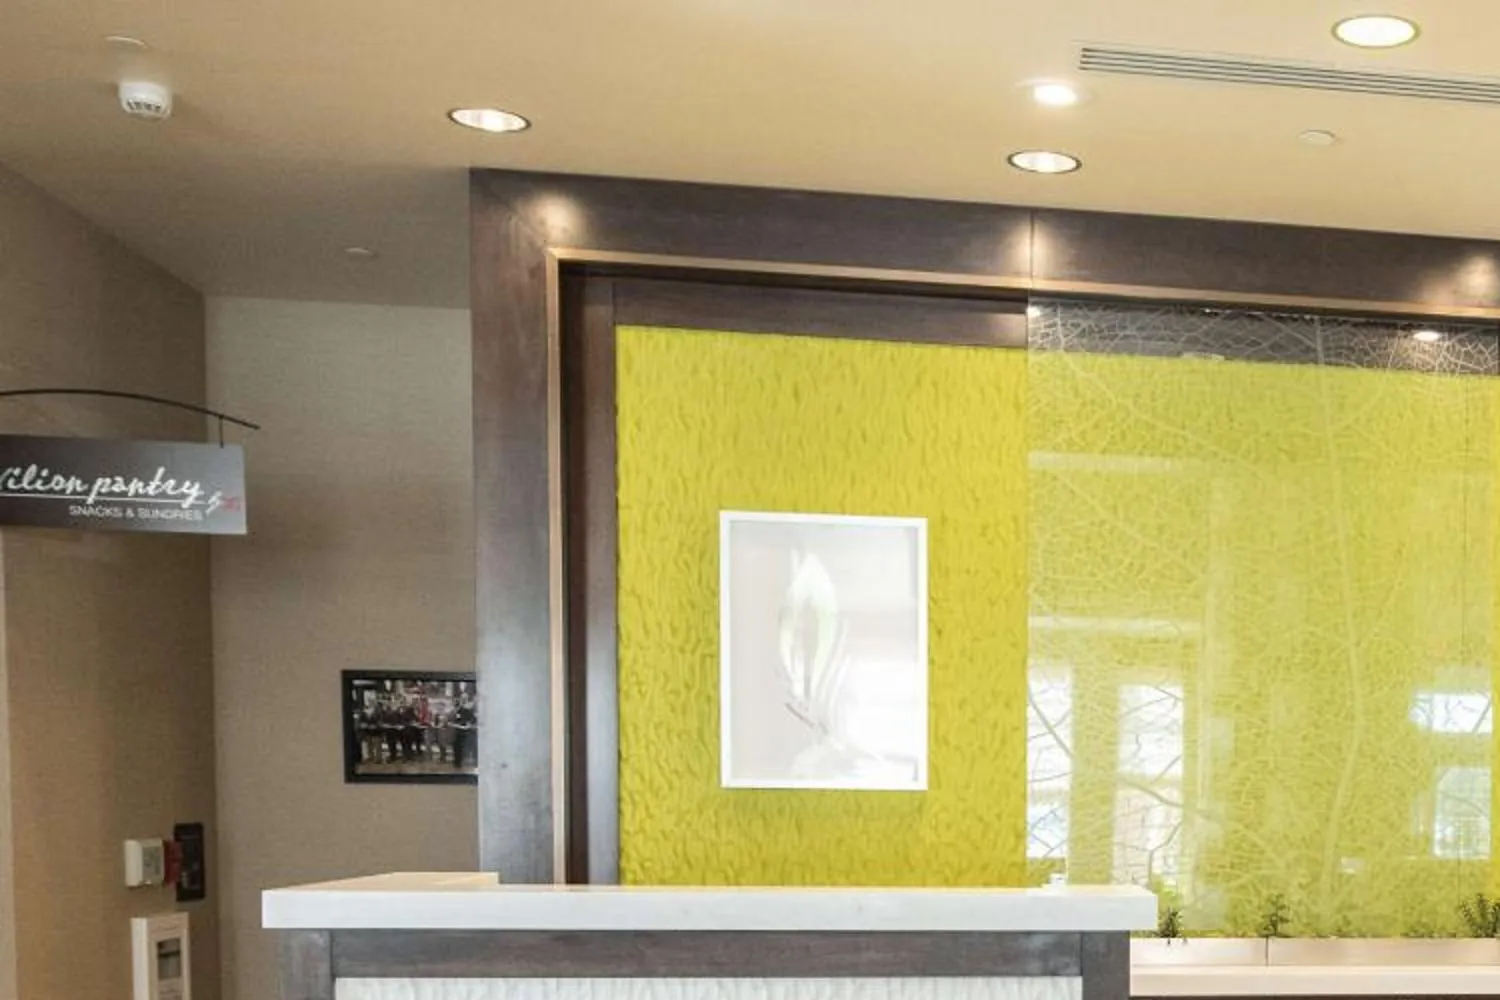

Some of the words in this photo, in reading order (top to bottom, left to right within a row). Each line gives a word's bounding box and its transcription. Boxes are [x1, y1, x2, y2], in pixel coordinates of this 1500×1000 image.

[86, 466, 204, 508] pantry
[69, 504, 122, 518] SNACKS
[125, 507, 135, 518] &
[138, 507, 203, 520] SUNDRIES
